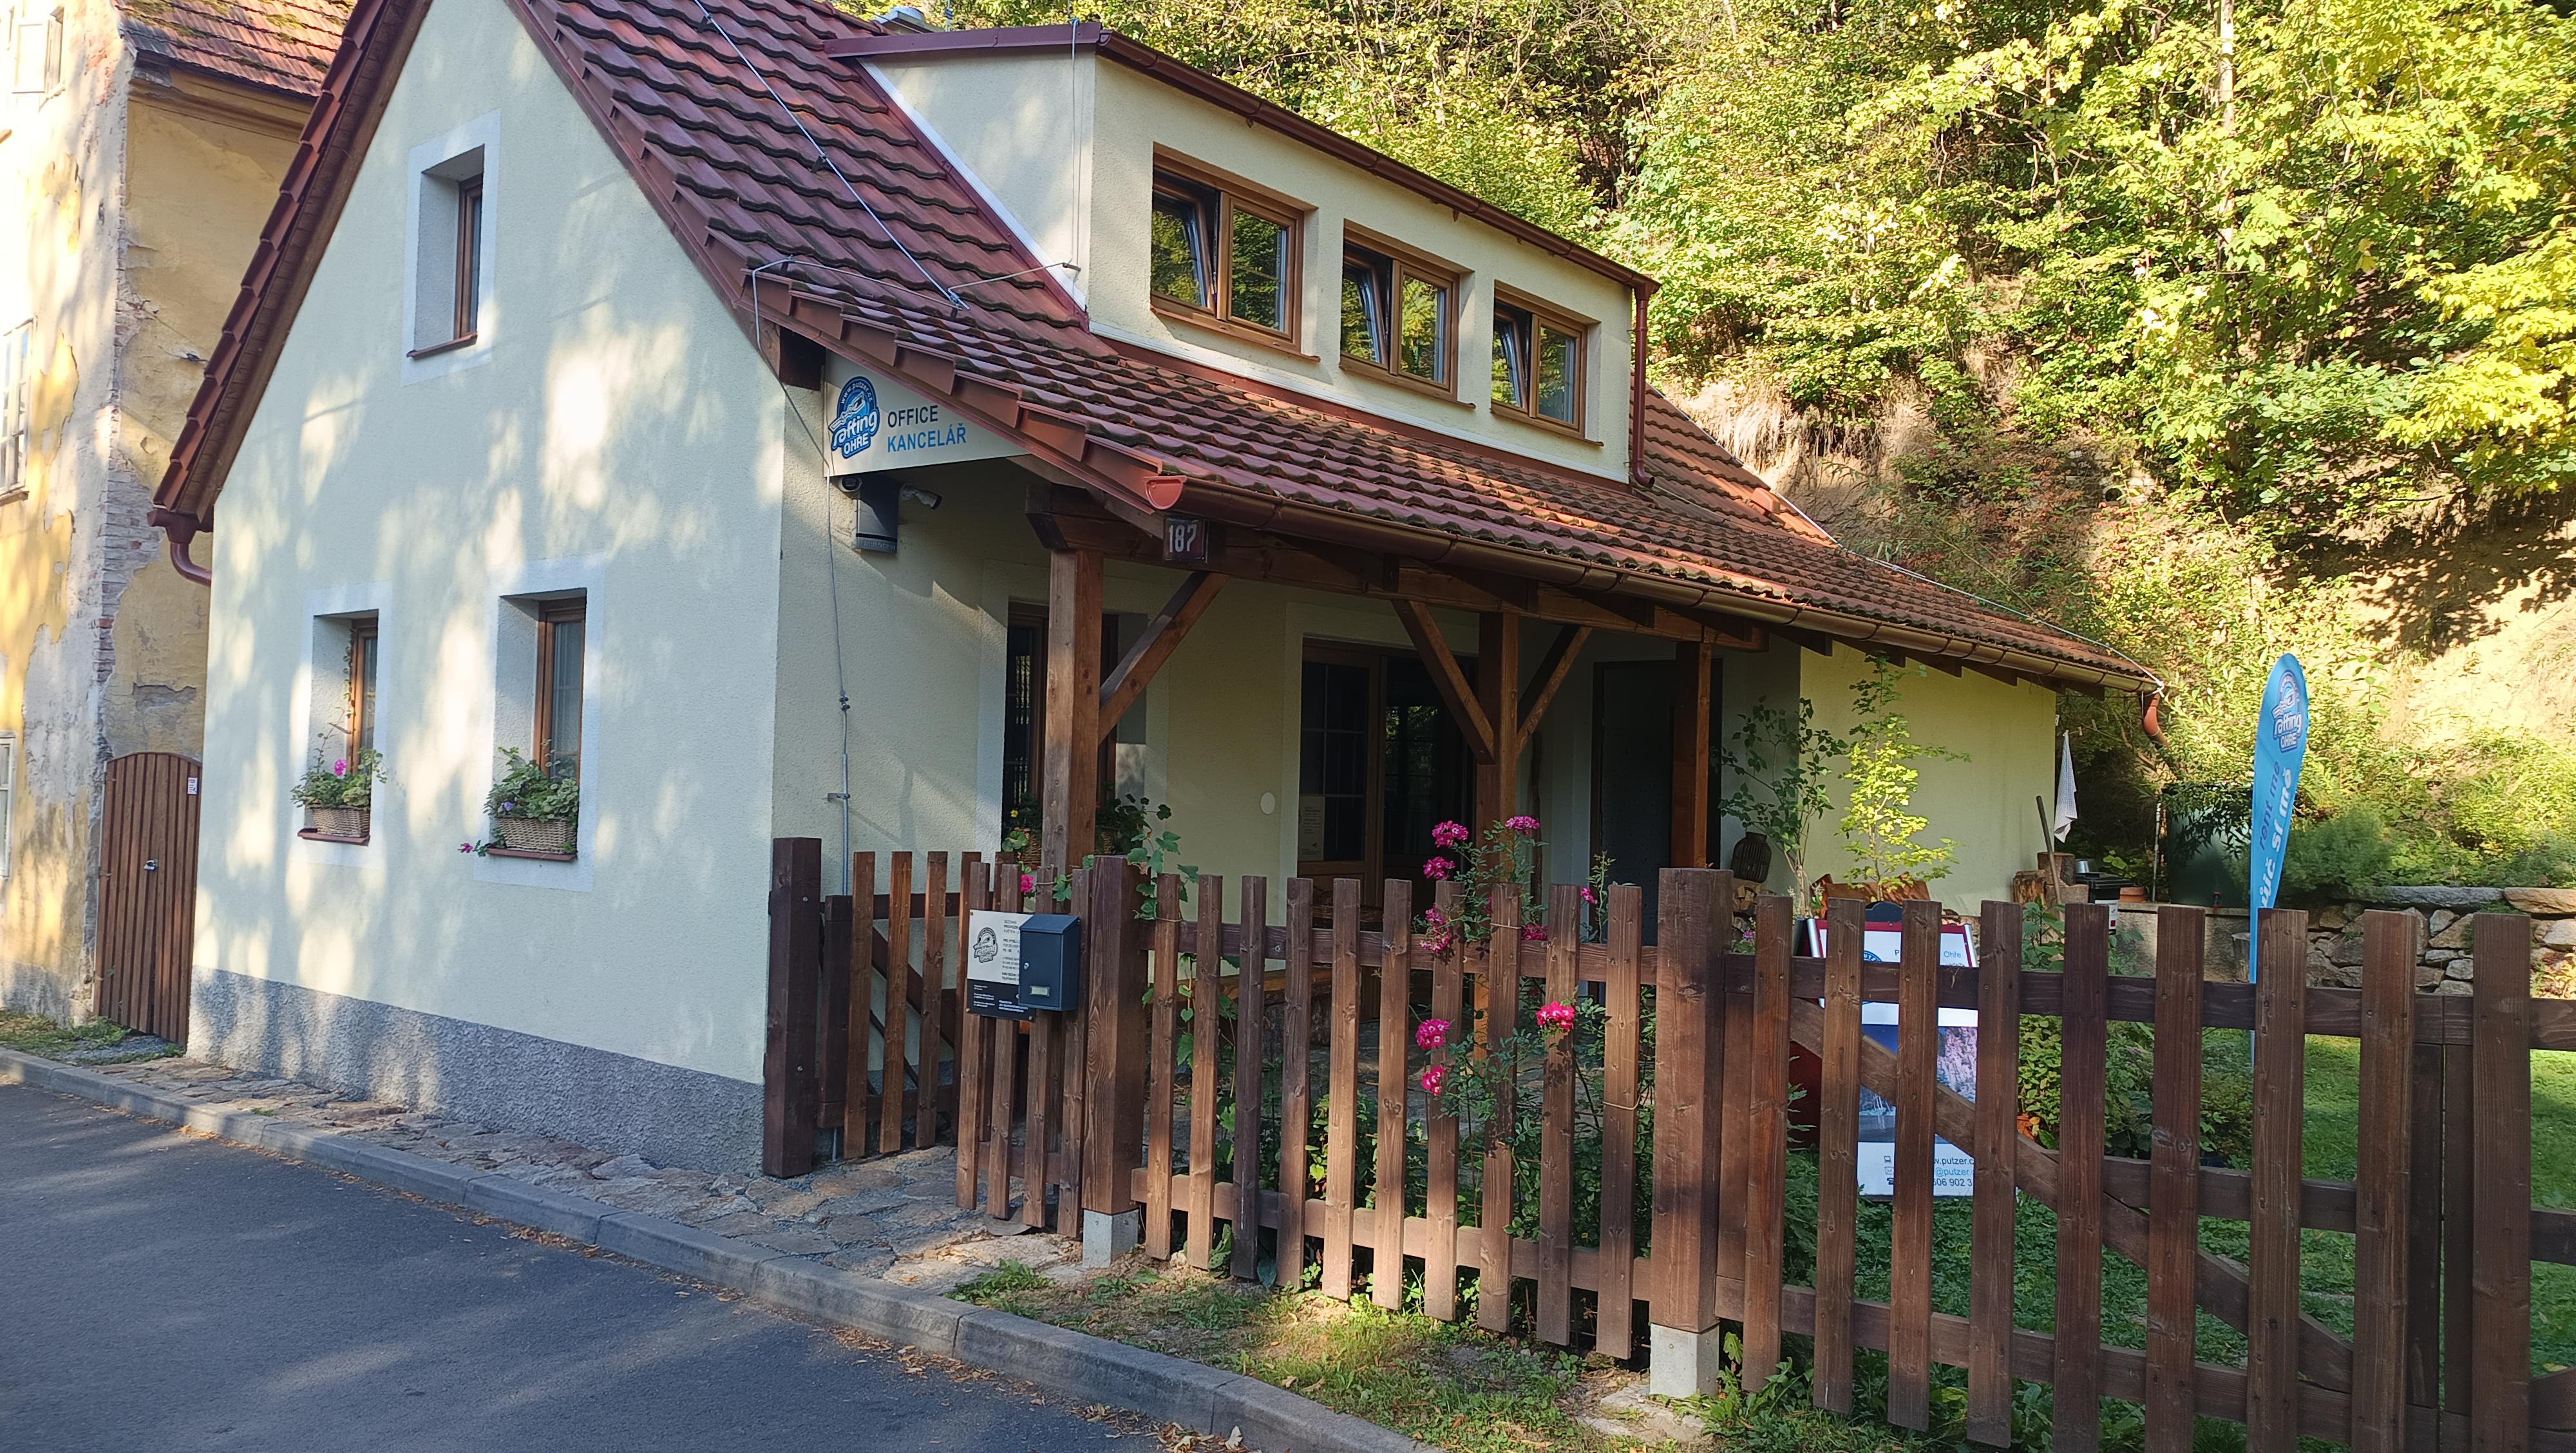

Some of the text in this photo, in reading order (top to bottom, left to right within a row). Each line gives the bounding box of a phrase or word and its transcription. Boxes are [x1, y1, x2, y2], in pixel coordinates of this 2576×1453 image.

[841, 381, 873, 404] www.putzer.cz
[888, 405, 938, 428] OFFICE
[833, 411, 877, 446] rafting
[887, 423, 967, 452] KANCELÁŘ
[844, 433, 869, 455] OHŘE
[1170, 524, 1197, 553] 187
[2275, 712, 2302, 735] rafting
[2260, 761, 2280, 851] rent me
[2260, 857, 2276, 908] ůjč
[1935, 1157, 1975, 1166] w.putzer.c
[1935, 1166, 1975, 1177] @putzer.
[1949, 1178, 1965, 1186] 902
